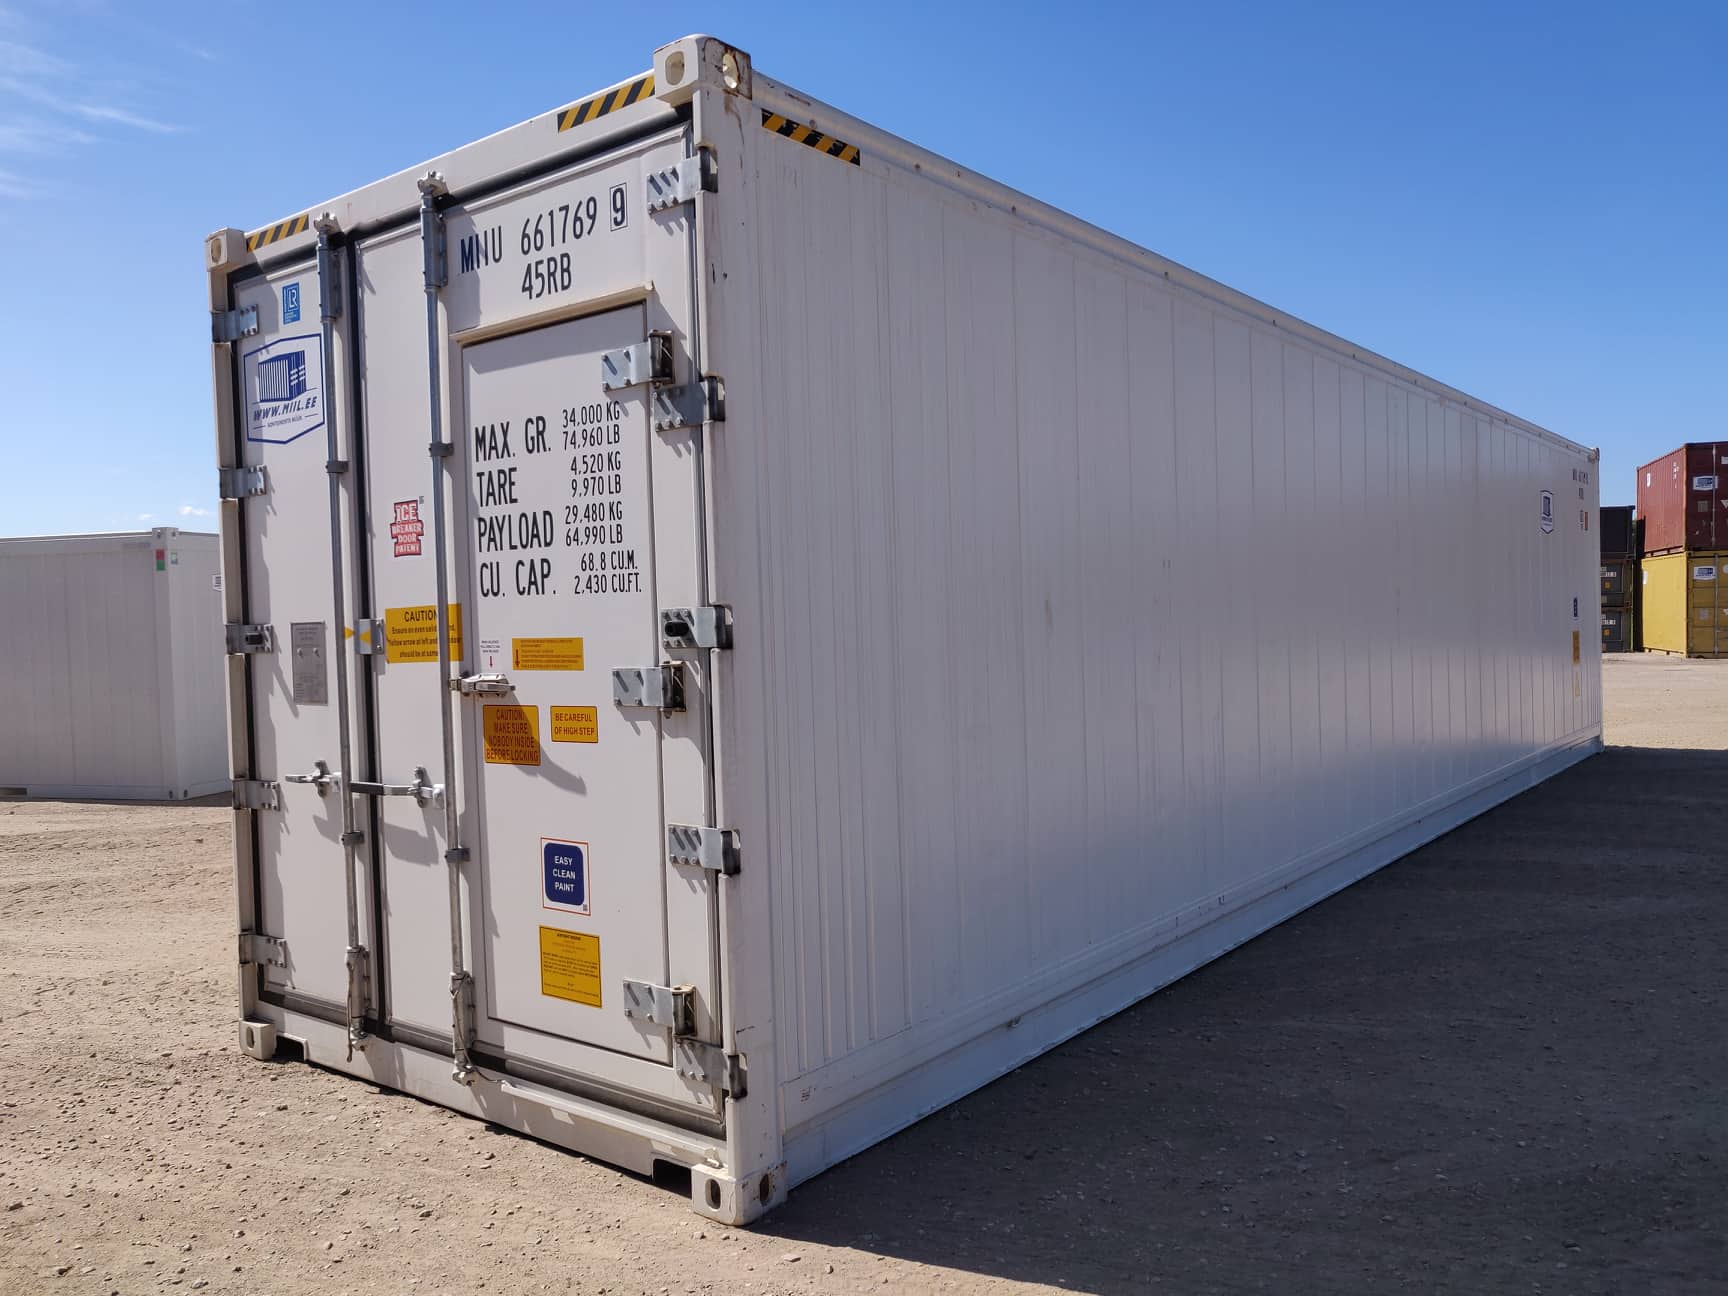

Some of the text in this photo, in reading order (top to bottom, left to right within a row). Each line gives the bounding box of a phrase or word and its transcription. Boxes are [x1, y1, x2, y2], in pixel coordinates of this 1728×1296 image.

[520, 196, 597, 255] 661769
[521, 252, 572, 300] 45RB
[253, 396, 317, 421] WWW.MIIL.EE
[562, 400, 620, 428] 34,000 KG
[475, 416, 552, 462] MAX. GR.
[562, 424, 620, 450] 74,960 LB
[570, 451, 621, 476] 4,520 KG
[476, 467, 519, 507] TARE
[571, 474, 622, 498] 9,970 LB
[395, 503, 417, 522] ICE
[565, 501, 623, 524] 29,480 KG
[398, 533, 417, 543] DOOR
[478, 510, 554, 553] PAYLOAD
[565, 523, 623, 547] 64,990 LB
[580, 550, 638, 572] 68.8 CU.M.
[480, 558, 556, 598] CU. CAP.
[574, 574, 608, 595] 2,430
[494, 722, 528, 735] MAKE SURE
[555, 713, 592, 722] BE CAREFUL
[488, 735, 535, 748] NOBODY INSIDE
[554, 726, 595, 736] OF HIGH STEP
[487, 748, 539, 761] BEFORE LOCKING
[554, 855, 573, 866] EASY
[552, 868, 576, 880] CLEAN
[554, 881, 576, 892] PAINT
